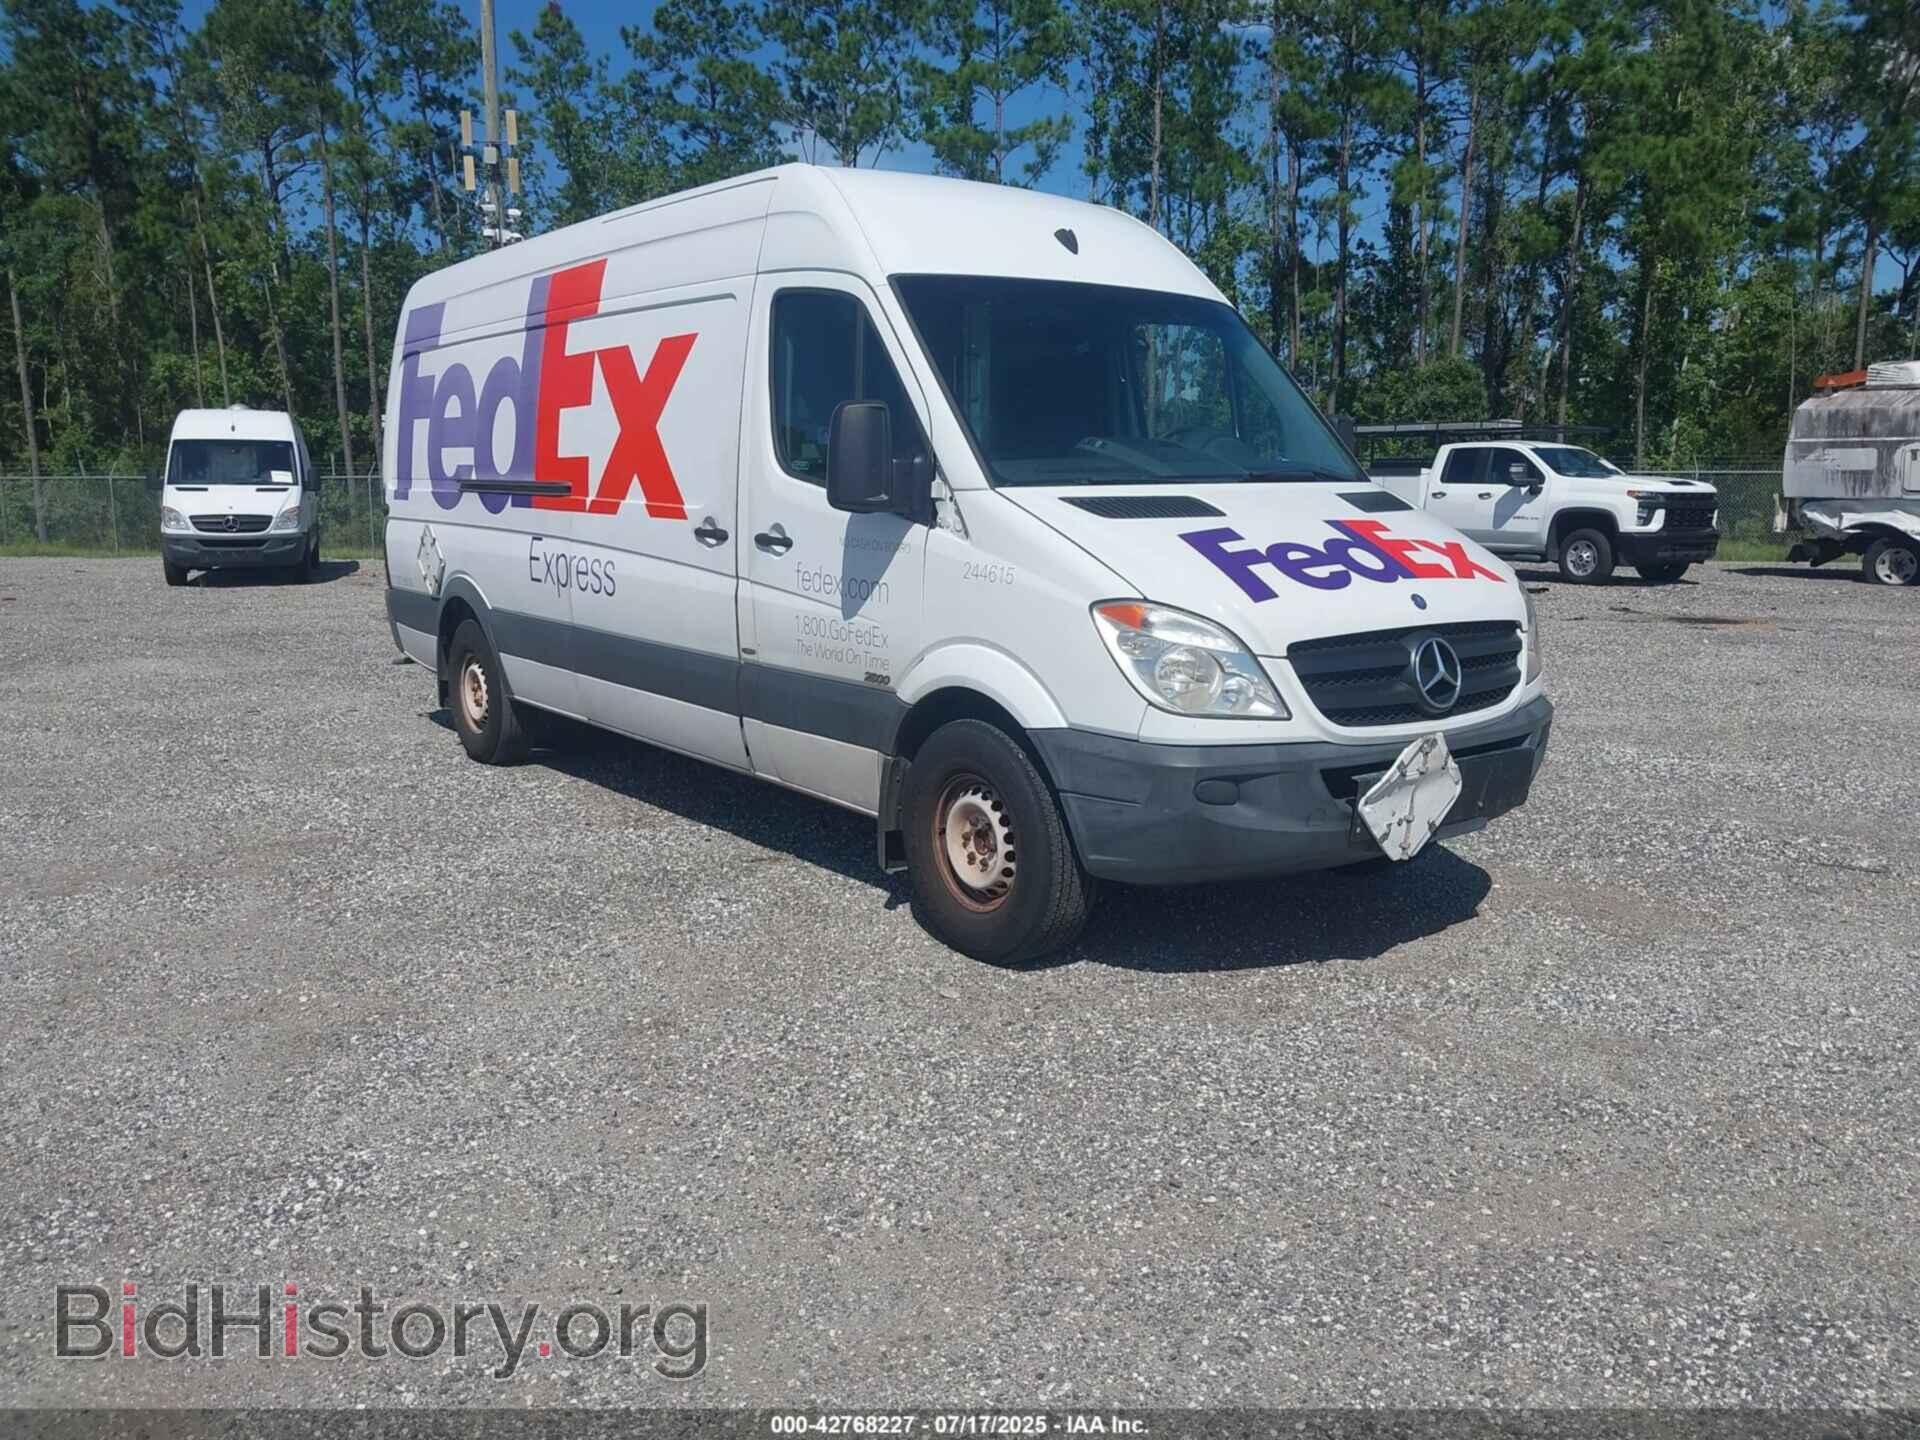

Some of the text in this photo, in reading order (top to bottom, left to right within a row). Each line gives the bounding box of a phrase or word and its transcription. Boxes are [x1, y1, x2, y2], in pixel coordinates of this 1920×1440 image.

[393, 258, 699, 520] FedEx
[529, 536, 616, 597] Express
[794, 561, 890, 605] fedex.com
[962, 561, 1017, 585] 244615
[1178, 519, 1506, 604] FedEx
[795, 638, 890, 671] The World On Time
